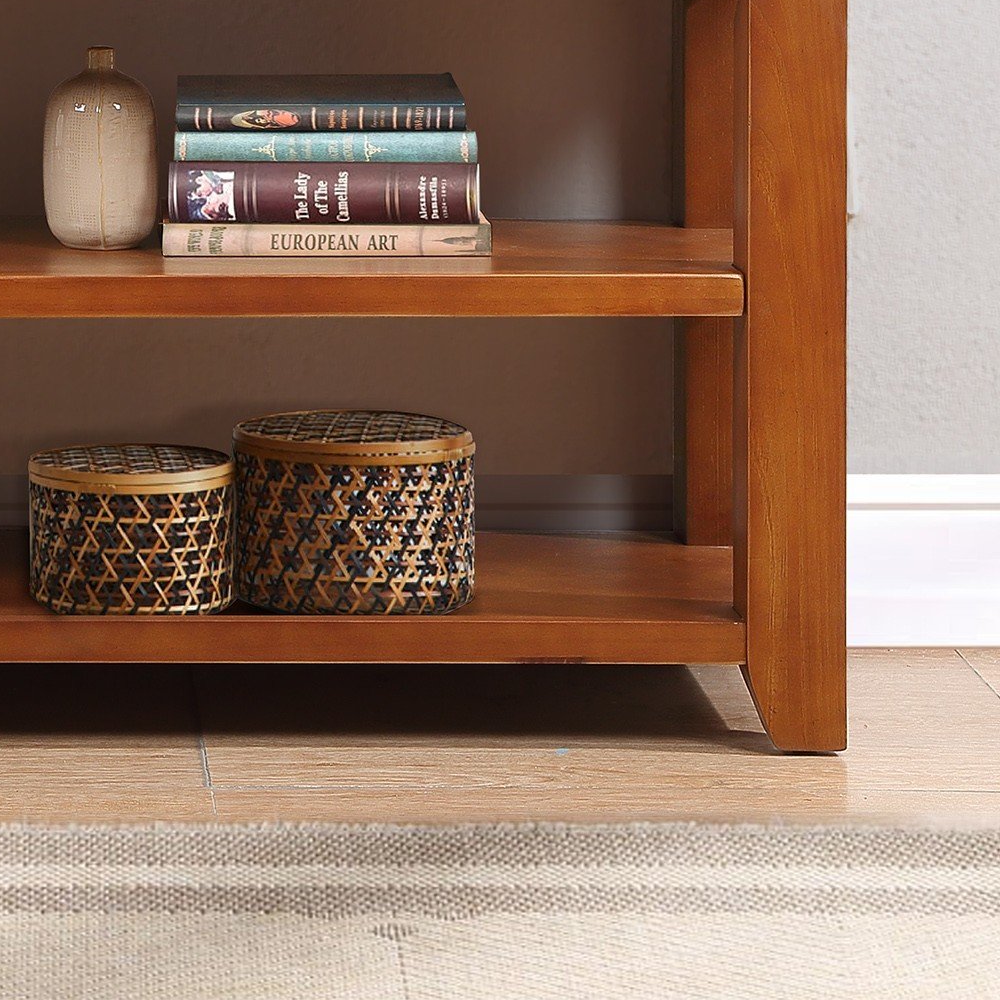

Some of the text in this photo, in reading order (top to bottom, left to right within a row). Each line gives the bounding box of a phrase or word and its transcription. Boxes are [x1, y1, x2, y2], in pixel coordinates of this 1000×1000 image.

[293, 172, 311, 200] Lady
[314, 180, 329, 215] of The
[334, 171, 350, 222] Camellias
[295, 201, 309, 220] The
[271, 233, 398, 250] EUROPEAN ART
